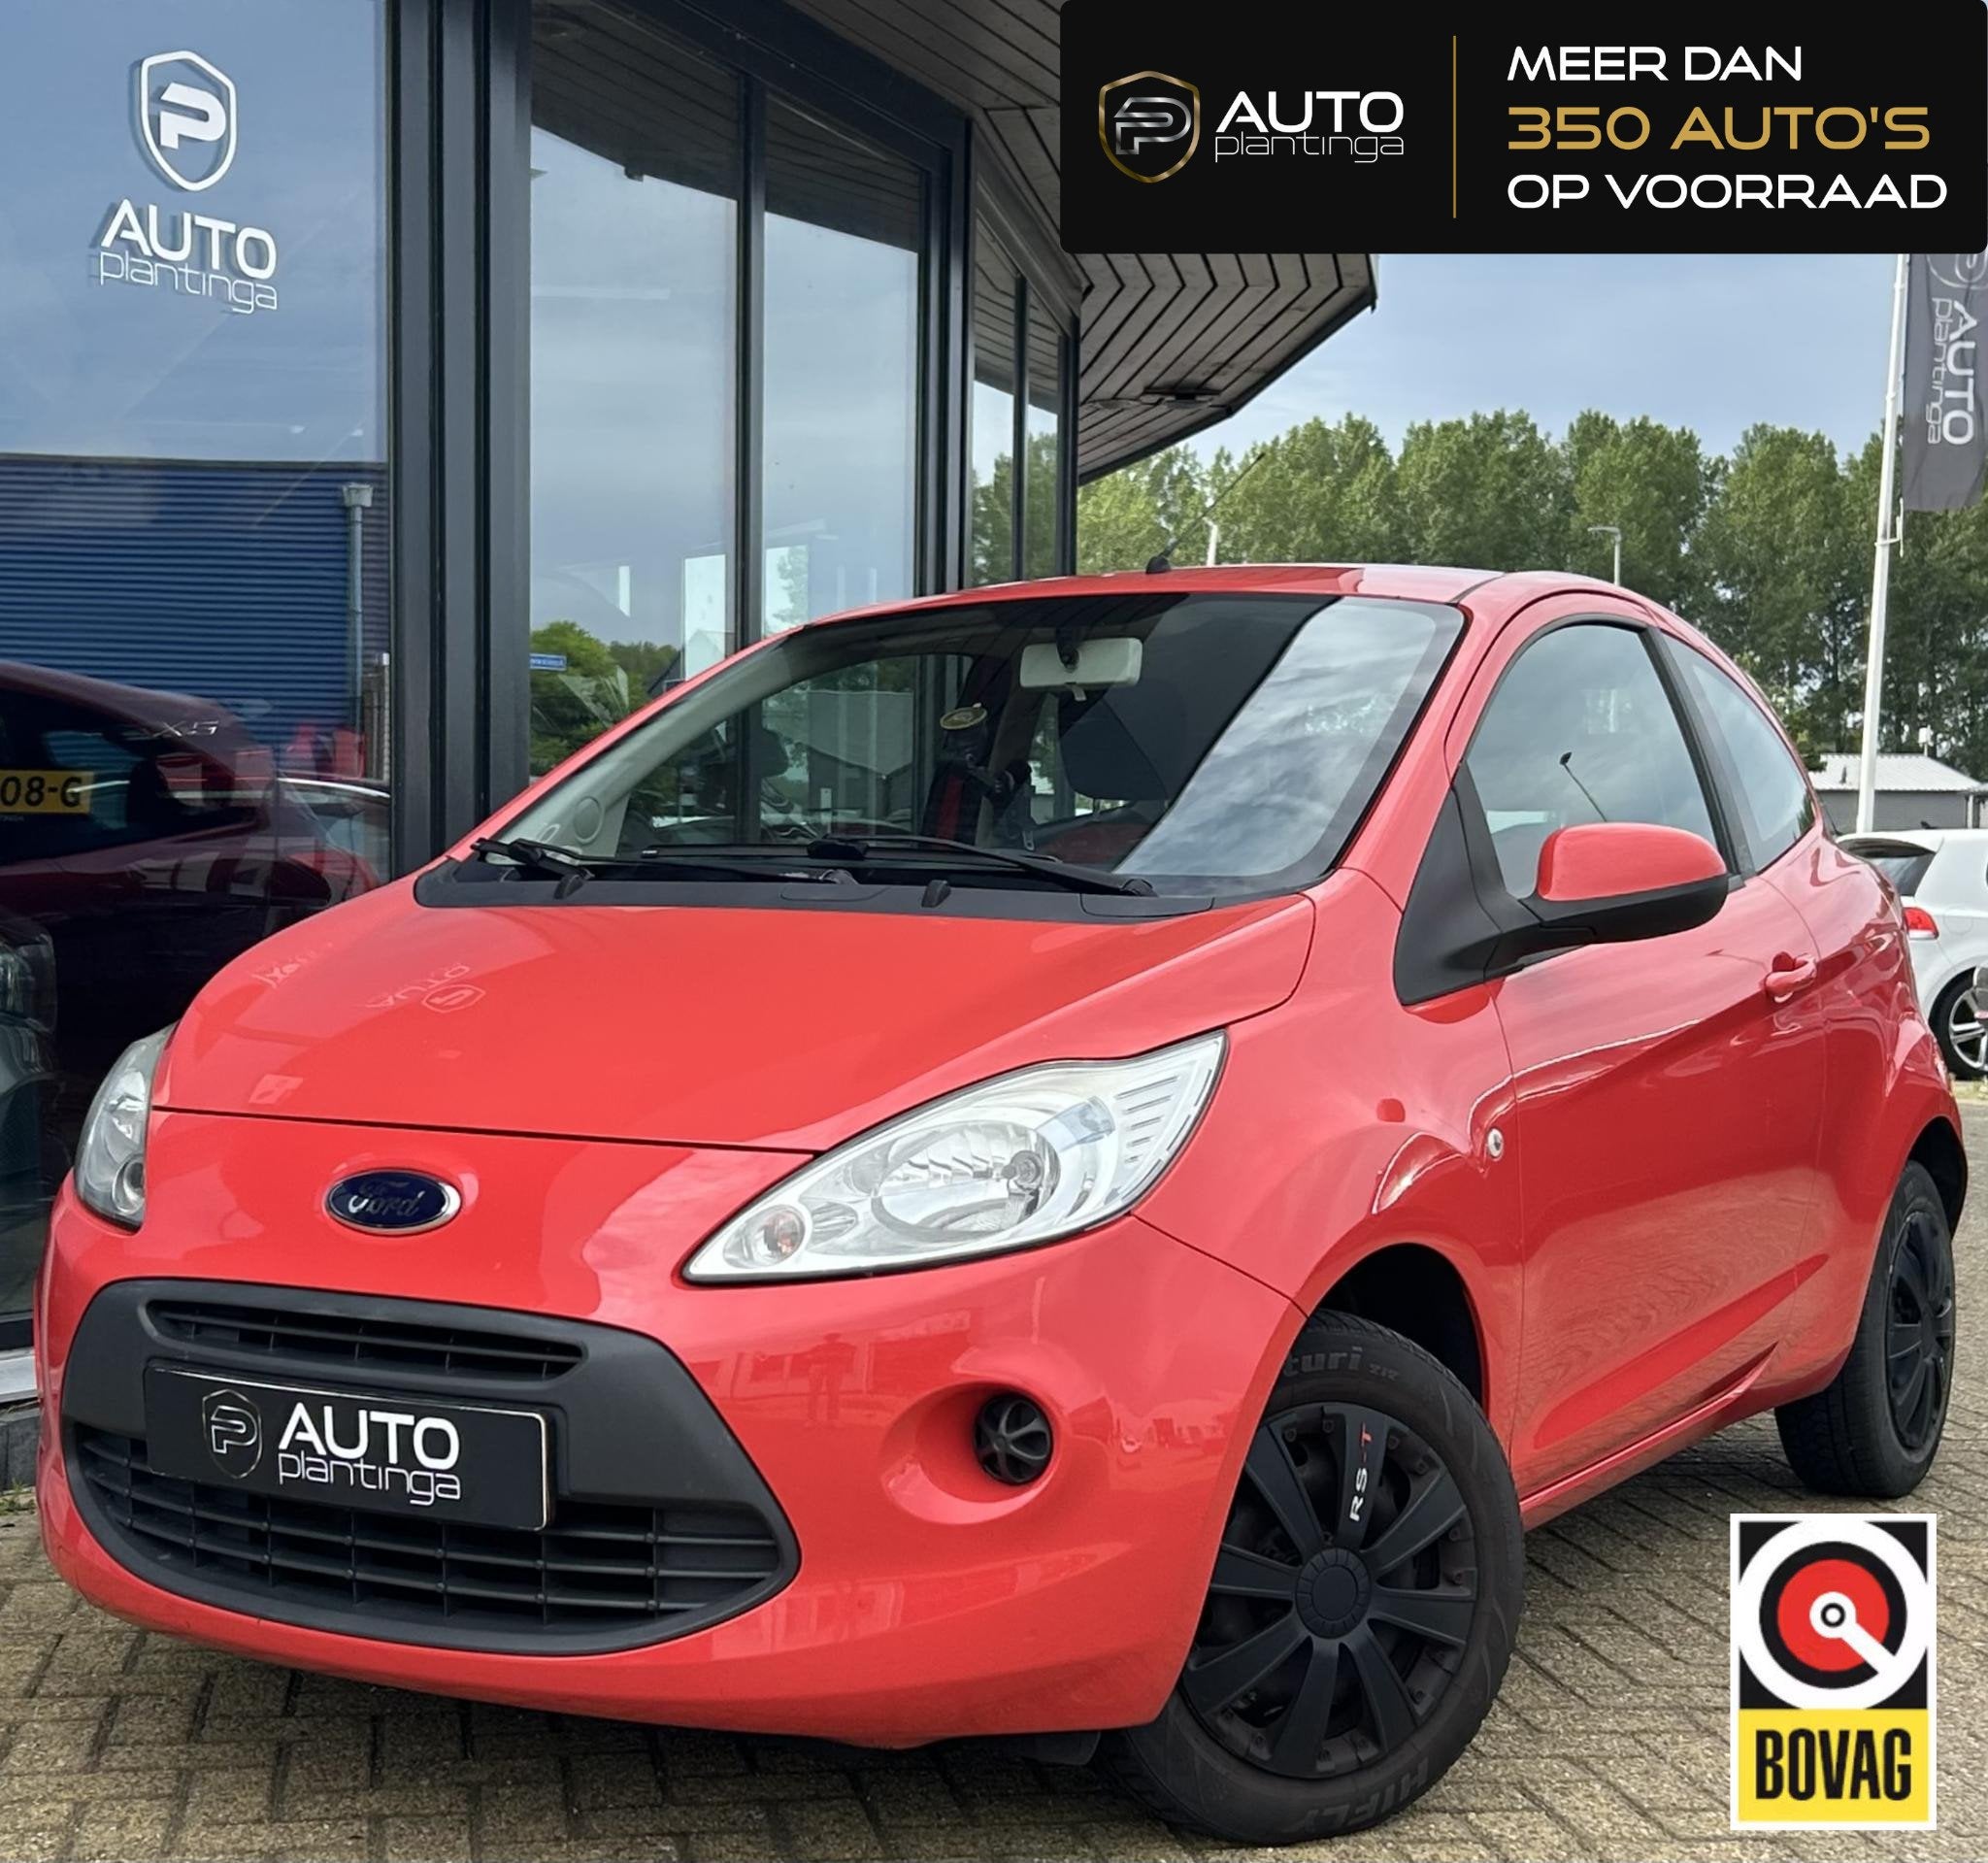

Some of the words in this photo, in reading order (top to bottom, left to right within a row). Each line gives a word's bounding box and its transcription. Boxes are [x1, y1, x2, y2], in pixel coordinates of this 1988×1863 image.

[100, 198, 277, 280] AUTO
[100, 250, 277, 314] plantinga
[1926, 296, 1955, 445] plantinga
[1942, 299, 1978, 446] AUTO
[278, 1402, 460, 1470] AUTO
[278, 1450, 461, 1506] plantinga
